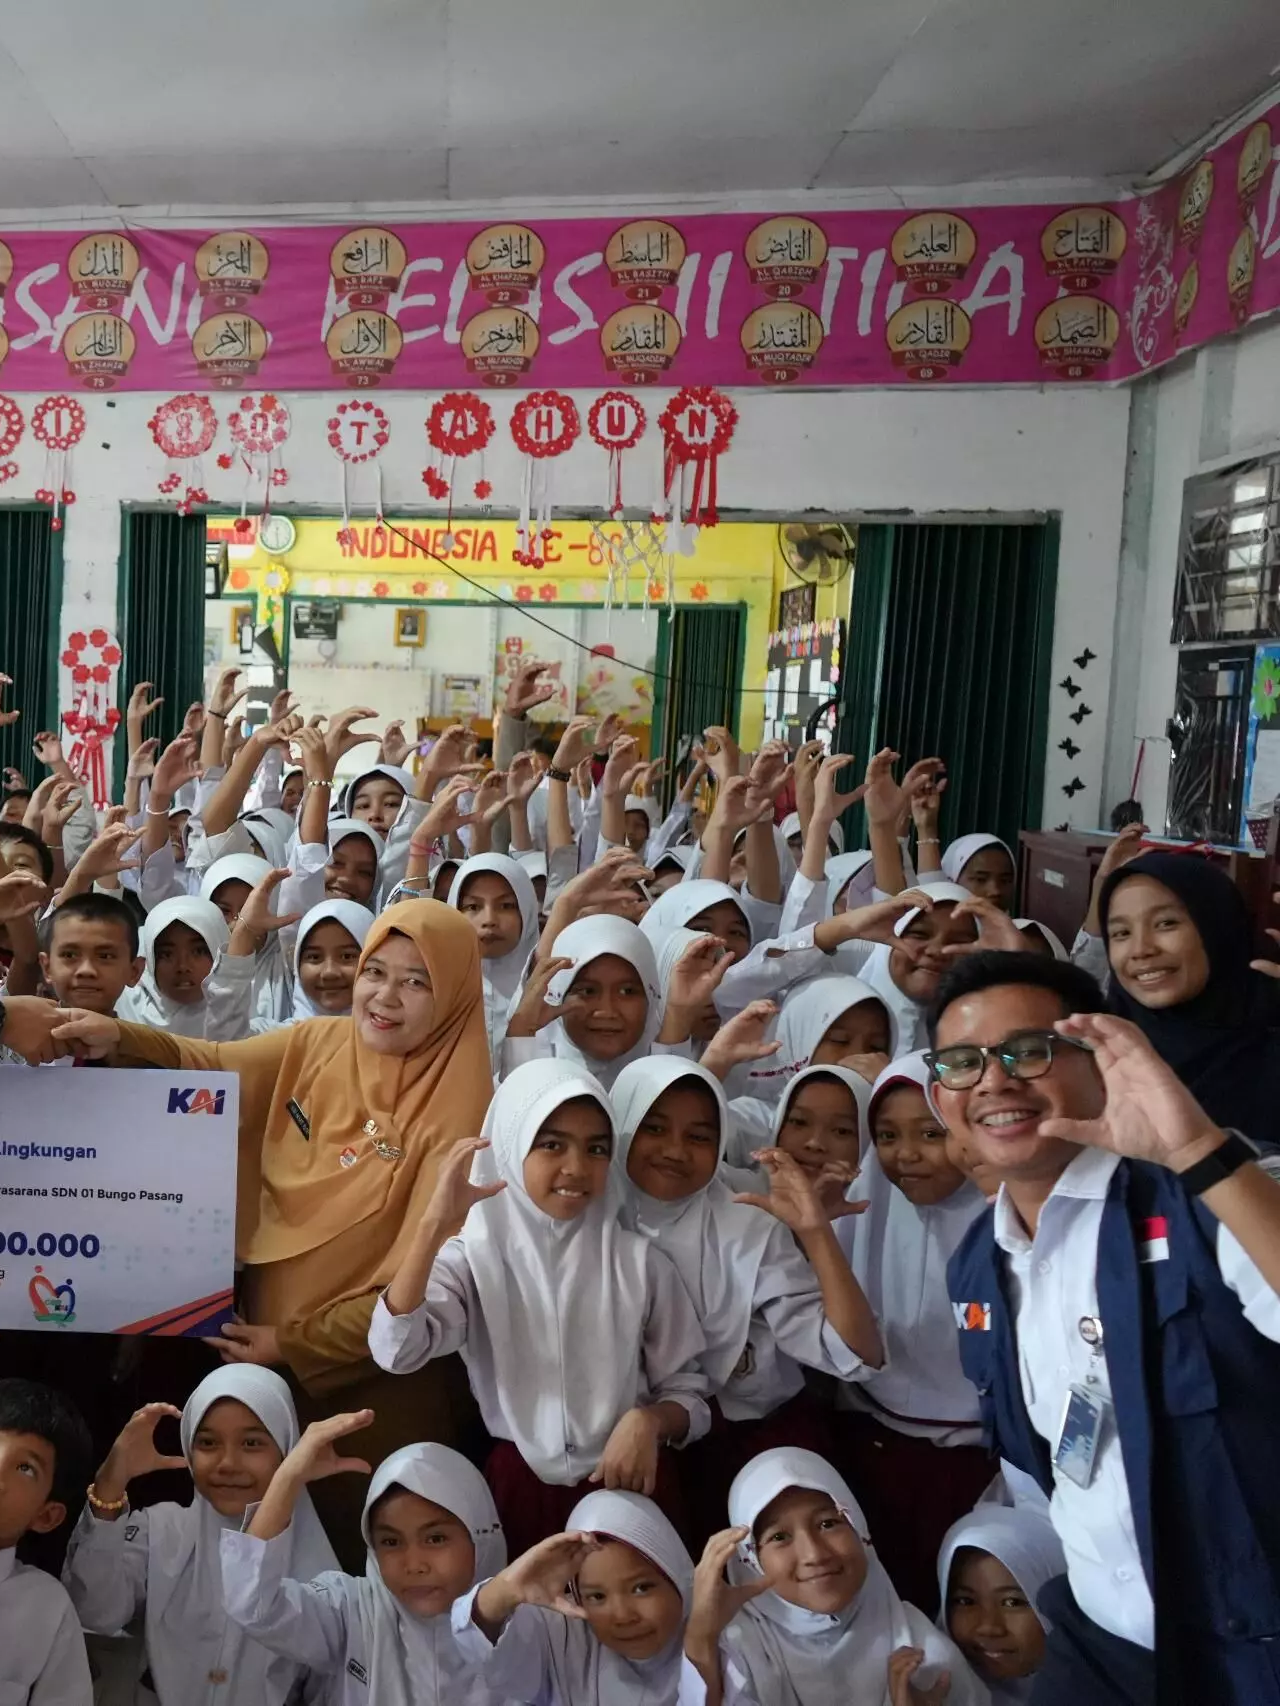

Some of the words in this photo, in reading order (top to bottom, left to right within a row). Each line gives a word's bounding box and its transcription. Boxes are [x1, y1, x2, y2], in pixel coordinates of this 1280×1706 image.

[167, 1087, 226, 1115] KAI
[51, 1186, 77, 1198] SDN
[81, 1187, 94, 1199] 01
[97, 1188, 136, 1202] Bungo
[139, 1190, 183, 1204] Pasang
[951, 1302, 991, 1331] KAI
